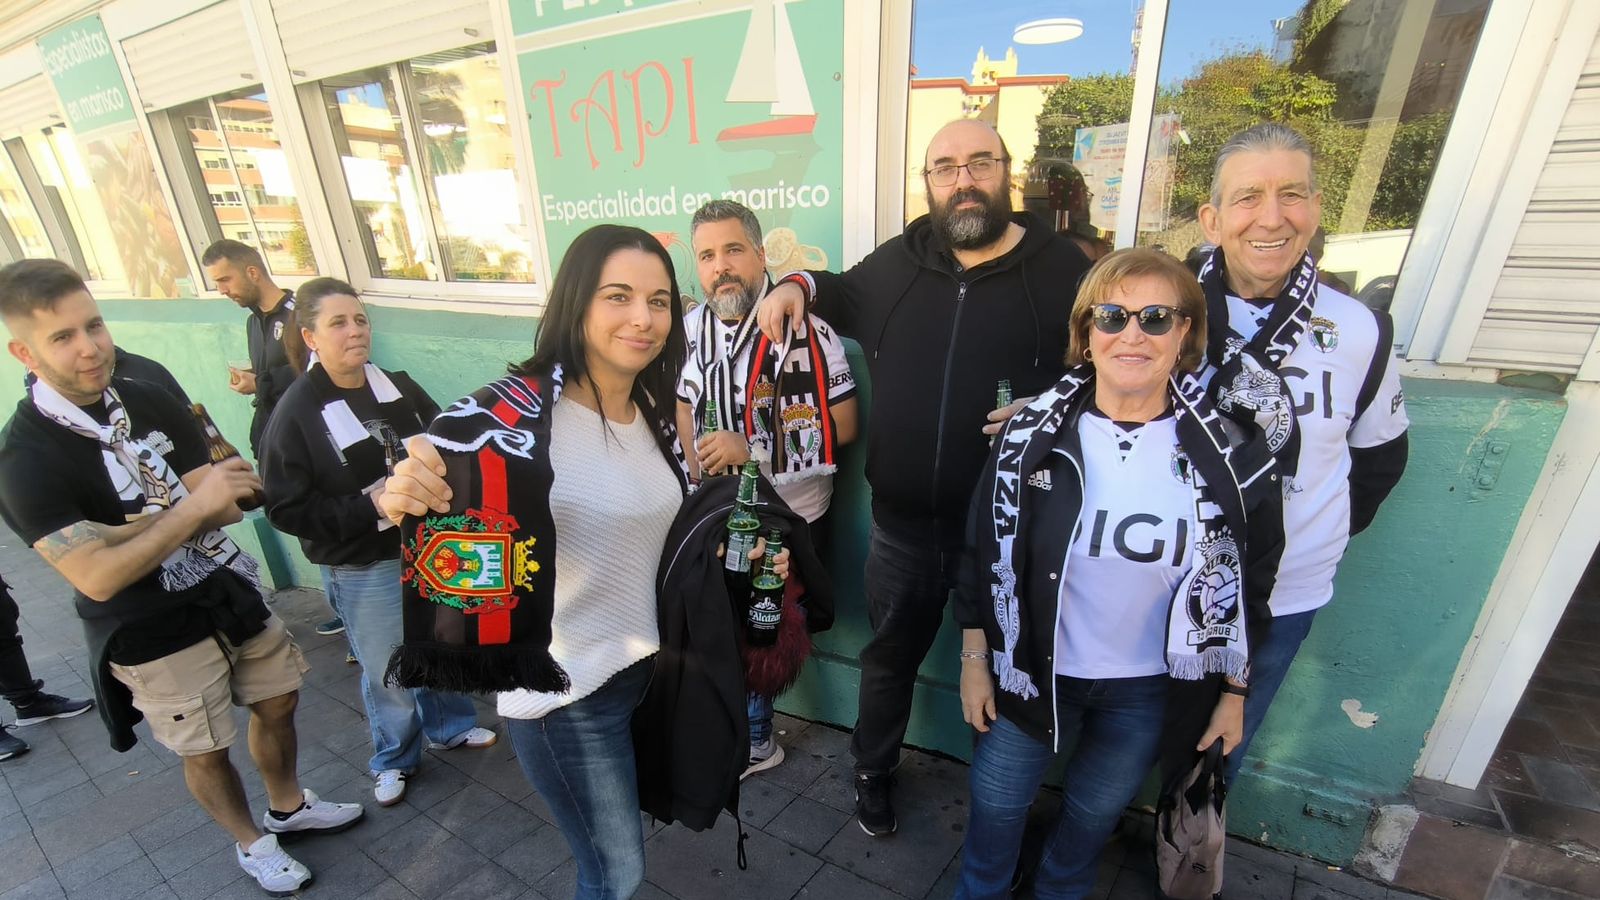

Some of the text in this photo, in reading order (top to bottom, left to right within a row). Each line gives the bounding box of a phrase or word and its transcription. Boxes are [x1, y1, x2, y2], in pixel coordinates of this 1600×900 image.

[39, 29, 110, 78] Especialistas
[67, 85, 124, 123] en marisco
[531, 57, 699, 170] TAPI
[542, 185, 677, 224] Especialidad
[1278, 365, 1332, 419] GI
[1028, 478, 1053, 491] adidas
[1078, 509, 1188, 567] IGI
